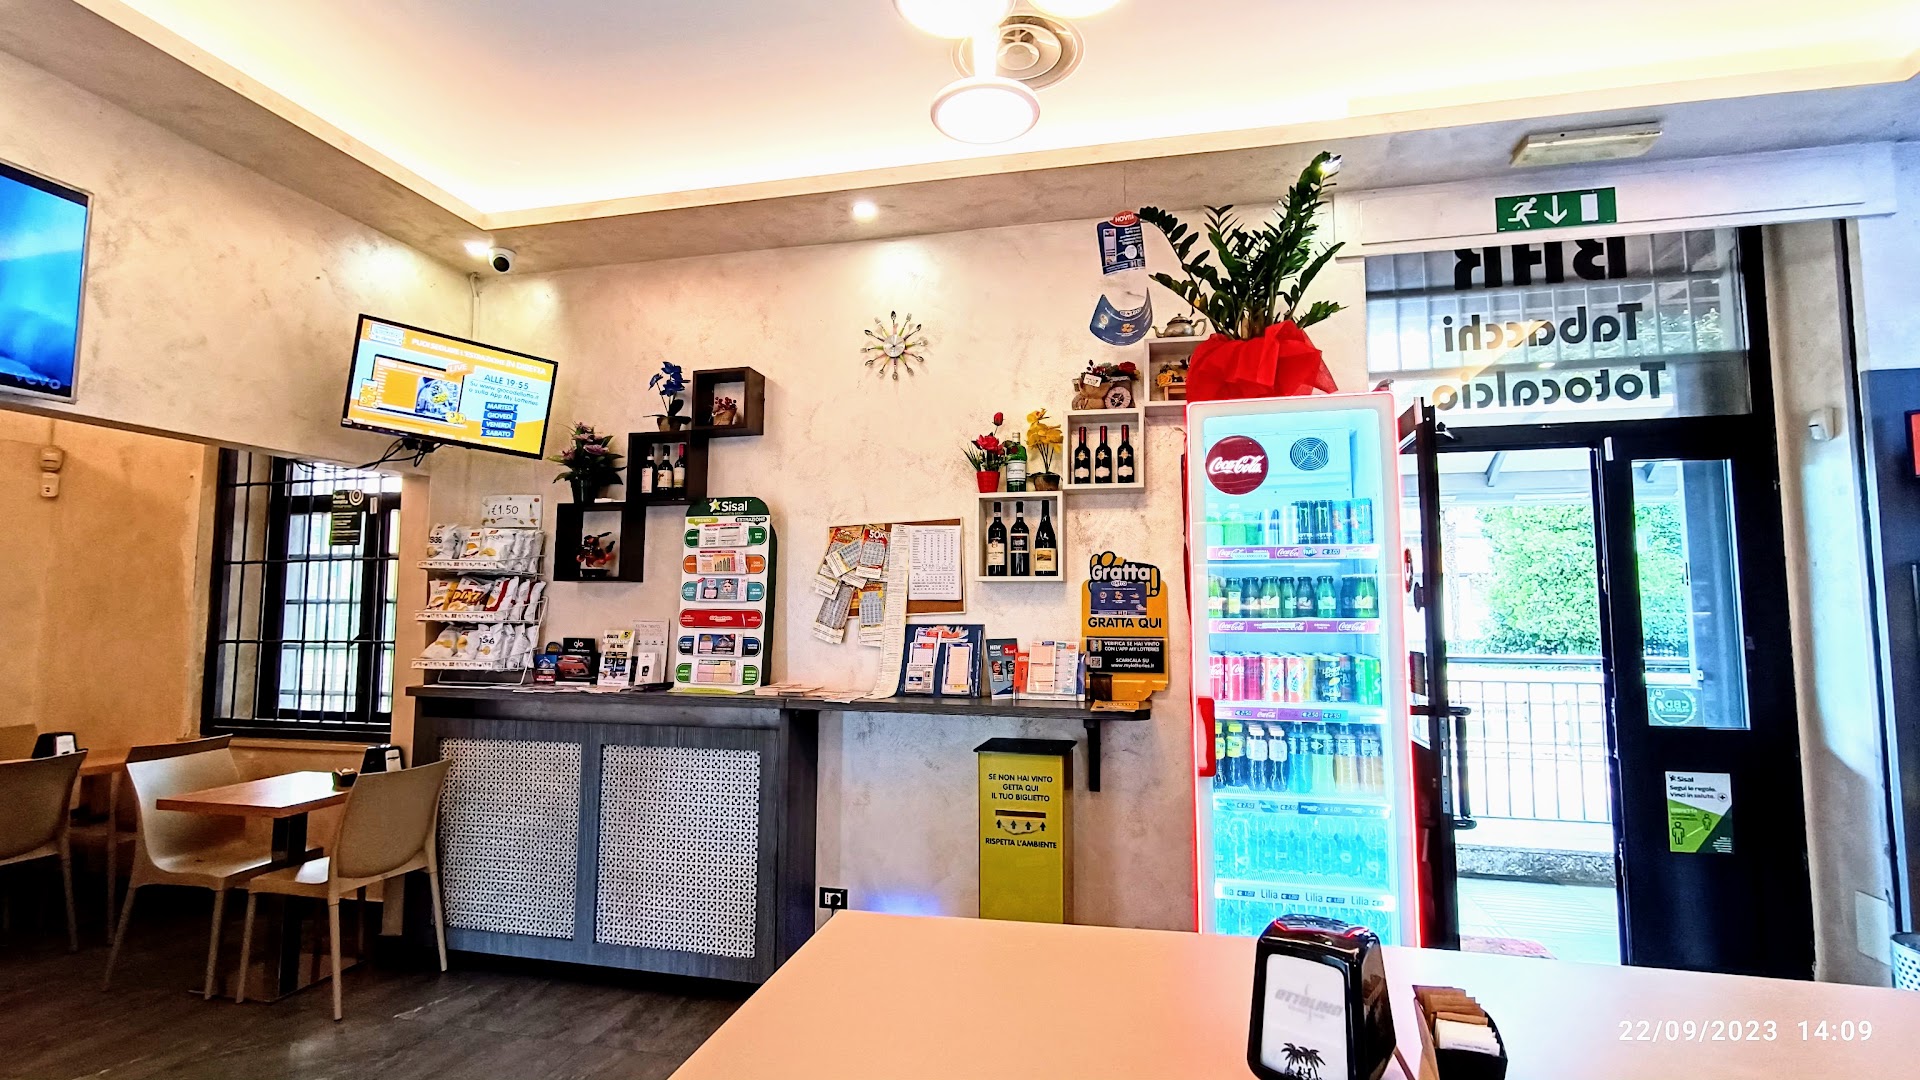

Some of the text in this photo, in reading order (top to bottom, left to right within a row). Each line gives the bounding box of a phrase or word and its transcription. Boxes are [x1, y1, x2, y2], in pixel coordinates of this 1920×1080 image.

[484, 374, 503, 385] ALLE
[485, 429, 511, 437] SABATO
[1208, 455, 1265, 475] Coca-Cola
[721, 500, 748, 512] Sisal
[1091, 563, 1151, 581] Gratta
[1088, 617, 1162, 629] GRATTA QUI
[988, 773, 997, 781] SE
[998, 774, 1015, 782] NON
[1031, 775, 1053, 783] VINTO
[1676, 775, 1694, 783] Sisal
[1002, 783, 1039, 792] GETTA QUI
[1669, 785, 1687, 793] Segui
[991, 792, 1050, 802] IL TUO BIGLIETTO
[985, 837, 1057, 849] RISPETTA L'AMBIENTE
[1260, 890, 1279, 900] Lilia
[1305, 892, 1323, 903] Lilia
[1351, 895, 1369, 906] Lilia
